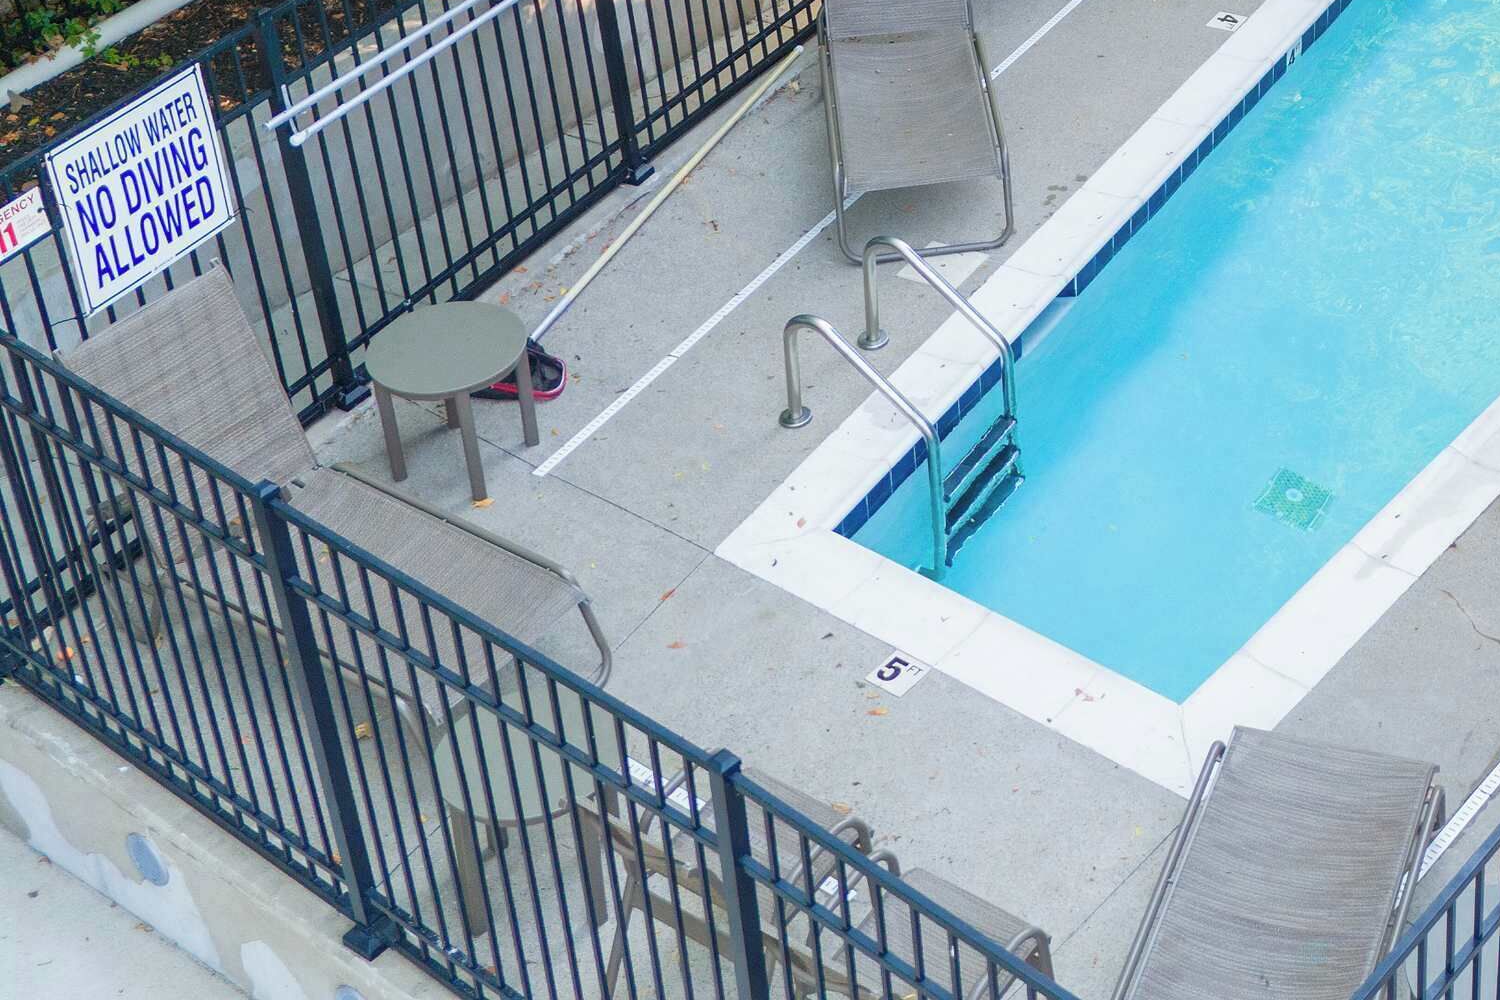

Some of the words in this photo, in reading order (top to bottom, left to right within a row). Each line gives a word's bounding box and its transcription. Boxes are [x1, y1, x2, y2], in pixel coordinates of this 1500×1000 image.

[1217, 15, 1238, 24] 4
[65, 124, 142, 195] SHALLOW
[143, 91, 198, 146] WATER
[76, 184, 117, 243] NO
[120, 127, 209, 216] DIVING
[94, 175, 215, 289] ALLOWED
[876, 656, 910, 682] 5
[906, 665, 924, 676] FT
